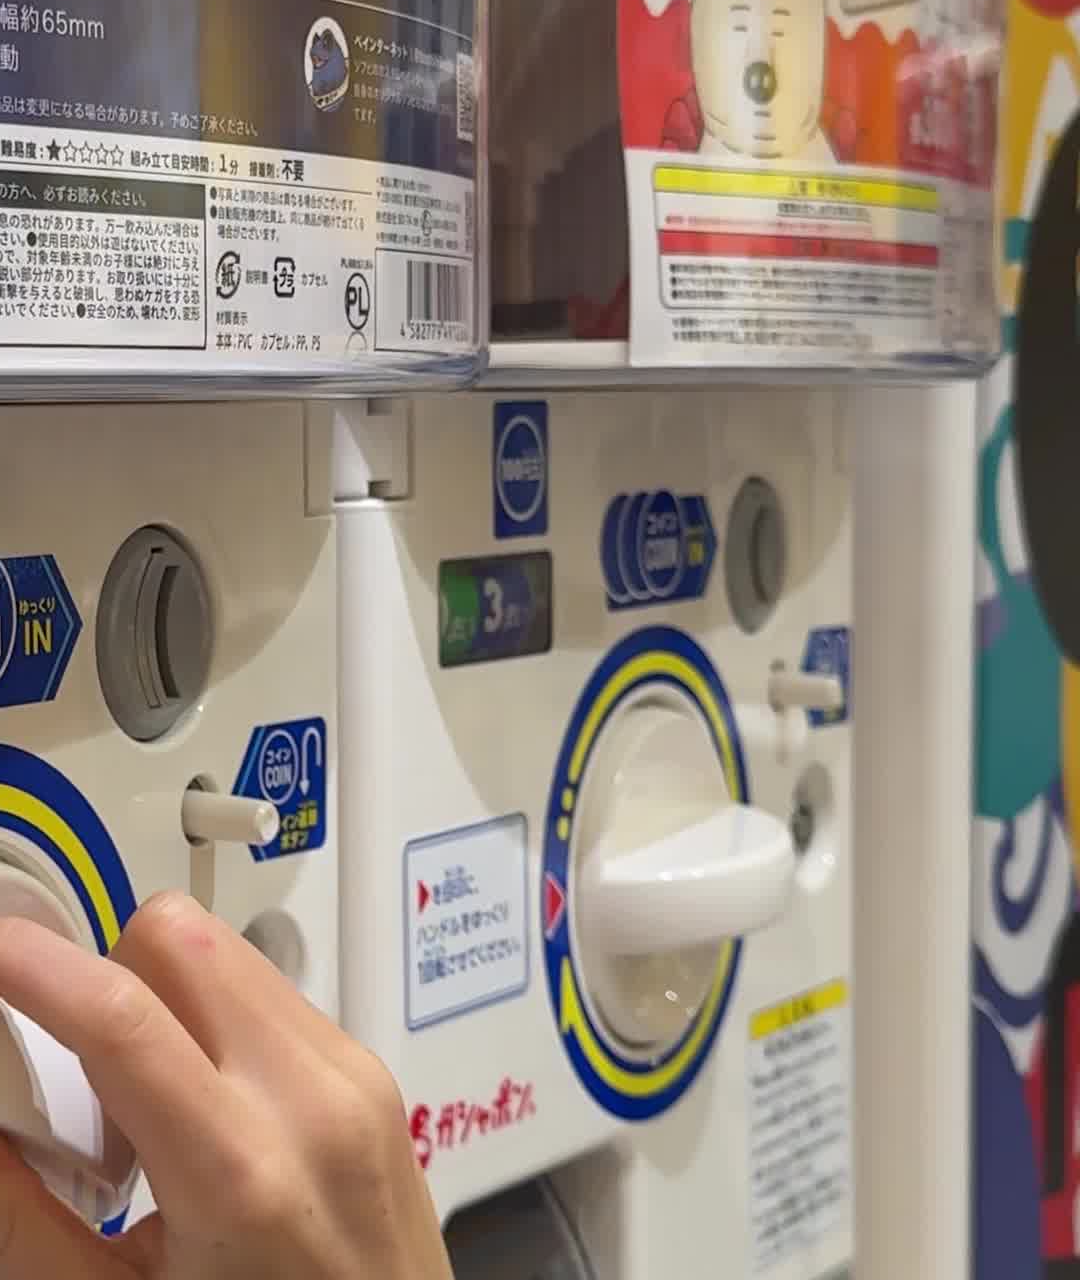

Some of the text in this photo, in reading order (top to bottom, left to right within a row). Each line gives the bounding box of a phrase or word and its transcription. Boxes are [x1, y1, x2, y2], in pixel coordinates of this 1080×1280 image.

[346, 286, 370, 318] PL
[19, 598, 57, 615] ゆっくり
[23, 618, 52, 656] IN
